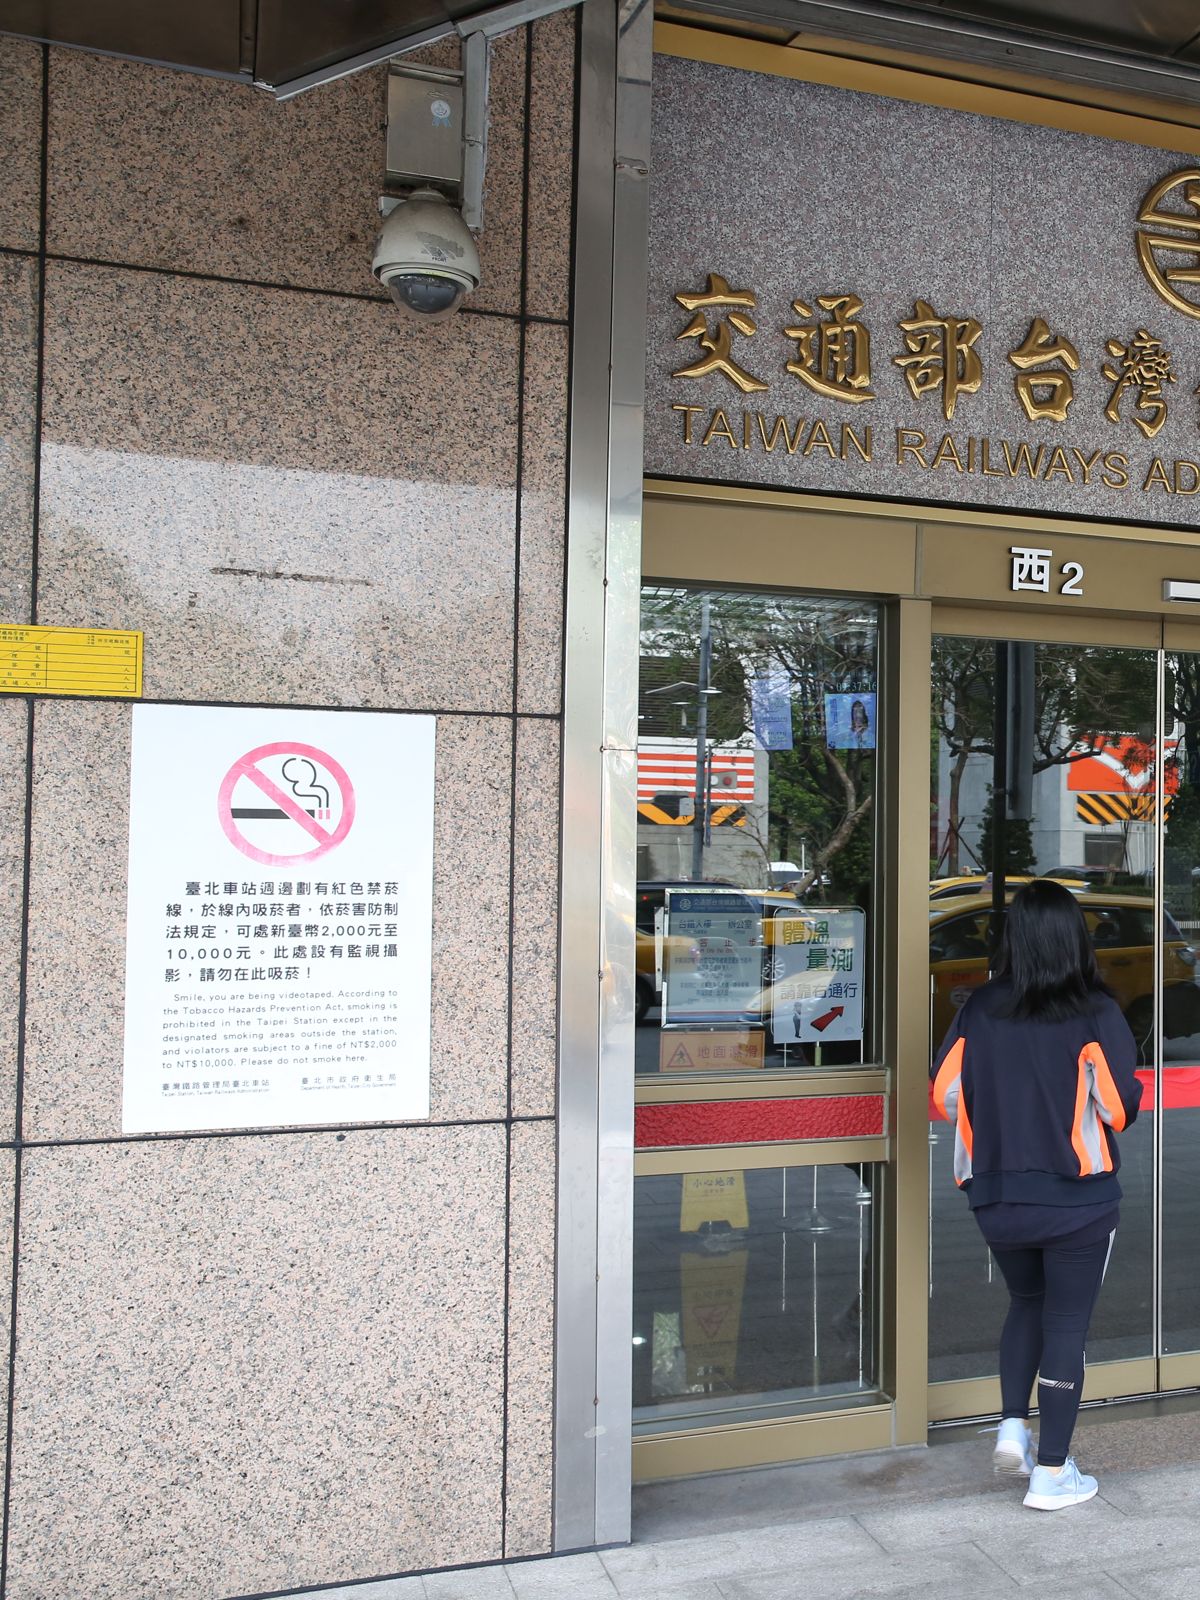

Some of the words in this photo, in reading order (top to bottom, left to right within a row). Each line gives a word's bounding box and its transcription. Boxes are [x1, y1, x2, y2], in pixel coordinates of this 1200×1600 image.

[672, 404, 873, 463] TAIWAN
[897, 428, 1131, 490] RAILWAYS
[783, 920, 830, 945] 體溫
[805, 948, 853, 972] 量測
[174, 993, 206, 1002] Smile,
[209, 994, 227, 1002] you
[248, 992, 276, 1001] being
[279, 991, 334, 999] videotaped.
[338, 989, 385, 998] According
[163, 1007, 179, 1015] the
[182, 1006, 225, 1015] Tobacco
[228, 1005, 266, 1013] Hazards
[270, 1004, 321, 1012] Prevention
[325, 1003, 344, 1011] Act,
[347, 1003, 386, 1011] smoking
[162, 1020, 216, 1029] prohibited
[257, 1018, 287, 1026] Taipei
[293, 1017, 328, 1025] Station
[332, 1016, 364, 1024] except
[162, 1033, 217, 1043] designated
[223, 1032, 264, 1040] smoking
[300, 1029, 336, 1037] outside
[362, 1028, 397, 1036] station,
[162, 1048, 180, 1056] and
[184, 1047, 230, 1055] violators
[252, 1044, 287, 1053] subject
[314, 1042, 333, 1050] fine
[350, 1039, 397, 1049] NT$2,000
[177, 1058, 236, 1068] NT$10,000.
[241, 1058, 273, 1066] Please
